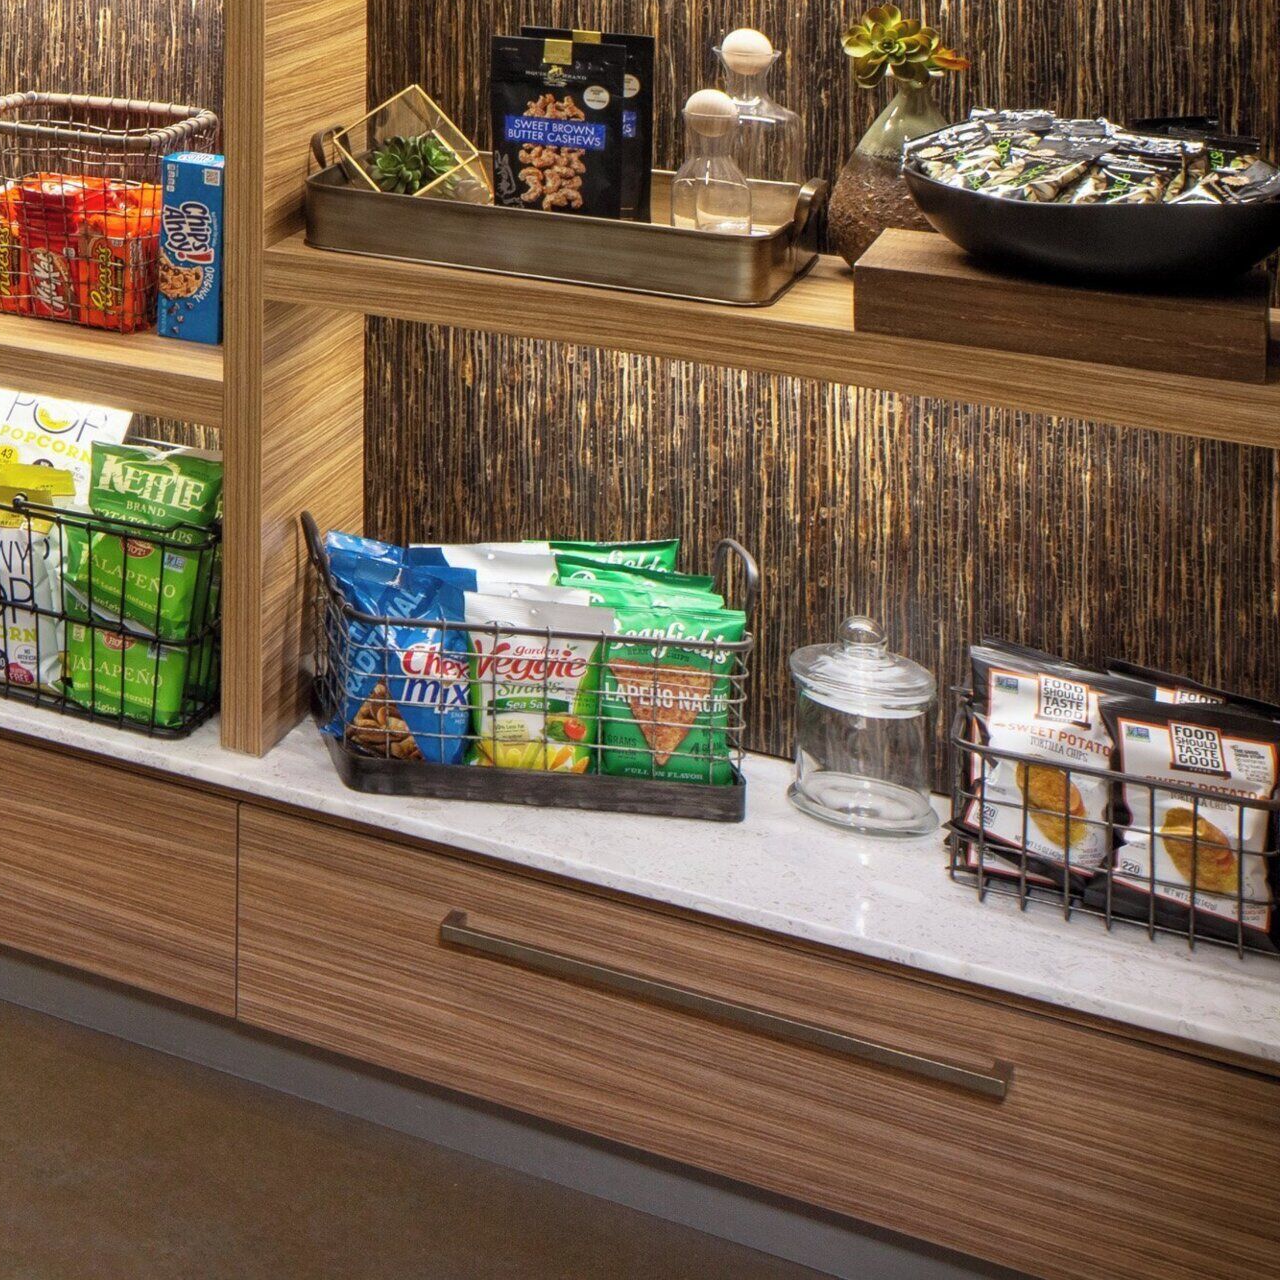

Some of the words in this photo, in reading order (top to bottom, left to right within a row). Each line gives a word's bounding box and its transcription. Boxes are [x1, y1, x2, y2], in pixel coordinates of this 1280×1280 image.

[514, 118, 548, 132] SWEET
[551, 122, 595, 136] BROWN
[507, 128, 544, 142] BUTTER
[546, 131, 602, 147] CASHEWS
[193, 266, 215, 303] ORIGINAL
[1, 448, 13, 459] 43
[94, 453, 206, 512] KETTLE
[126, 501, 166, 517] BRAND
[401, 644, 469, 678] Chex
[474, 639, 587, 680] Veggie
[10, 673, 29, 682] FREE
[1044, 678, 1083, 693] FOOD
[1043, 688, 1083, 701] SHOULD
[505, 700, 525, 710] Sea
[1045, 696, 1083, 711] TASTE
[1044, 707, 1082, 720] GOOD
[1174, 726, 1216, 741] FOOD
[1030, 736, 1063, 755] TORTILLA
[1066, 747, 1088, 762] CHIPS
[1058, 731, 1111, 756] POTATO
[1175, 736, 1217, 750] SHOULD
[1179, 745, 1218, 759] TASTE
[1179, 754, 1220, 768] GOOD
[624, 766, 649, 776] FULL
[667, 771, 703, 780] FLAVOR
[1122, 861, 1140, 874] 220
